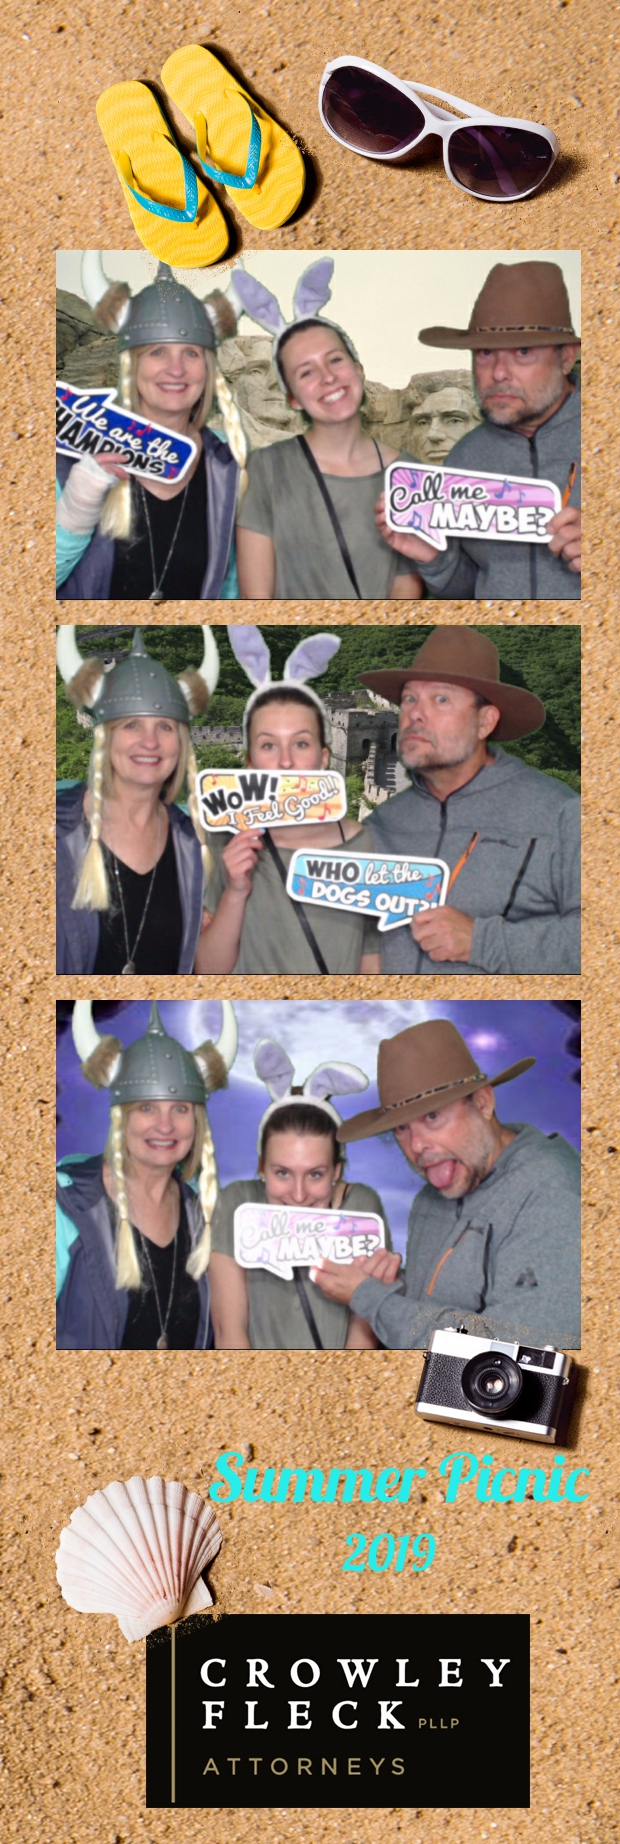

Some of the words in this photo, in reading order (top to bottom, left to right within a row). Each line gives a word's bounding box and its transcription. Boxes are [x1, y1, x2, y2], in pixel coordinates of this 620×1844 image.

[71, 395, 108, 430] We
[109, 427, 143, 450] are
[146, 438, 179, 464] the
[389, 472, 445, 513] Call
[450, 485, 488, 501] me
[429, 502, 555, 536] MAYBE?
[226, 810, 239, 826] I
[243, 801, 284, 826] Feel
[305, 860, 361, 883] WHO
[364, 863, 390, 885] let
[391, 862, 423, 884] the
[311, 881, 371, 908] DOGS
[240, 1211, 290, 1250] Call
[295, 1220, 326, 1234] me
[276, 1233, 381, 1262] MAYBE?
